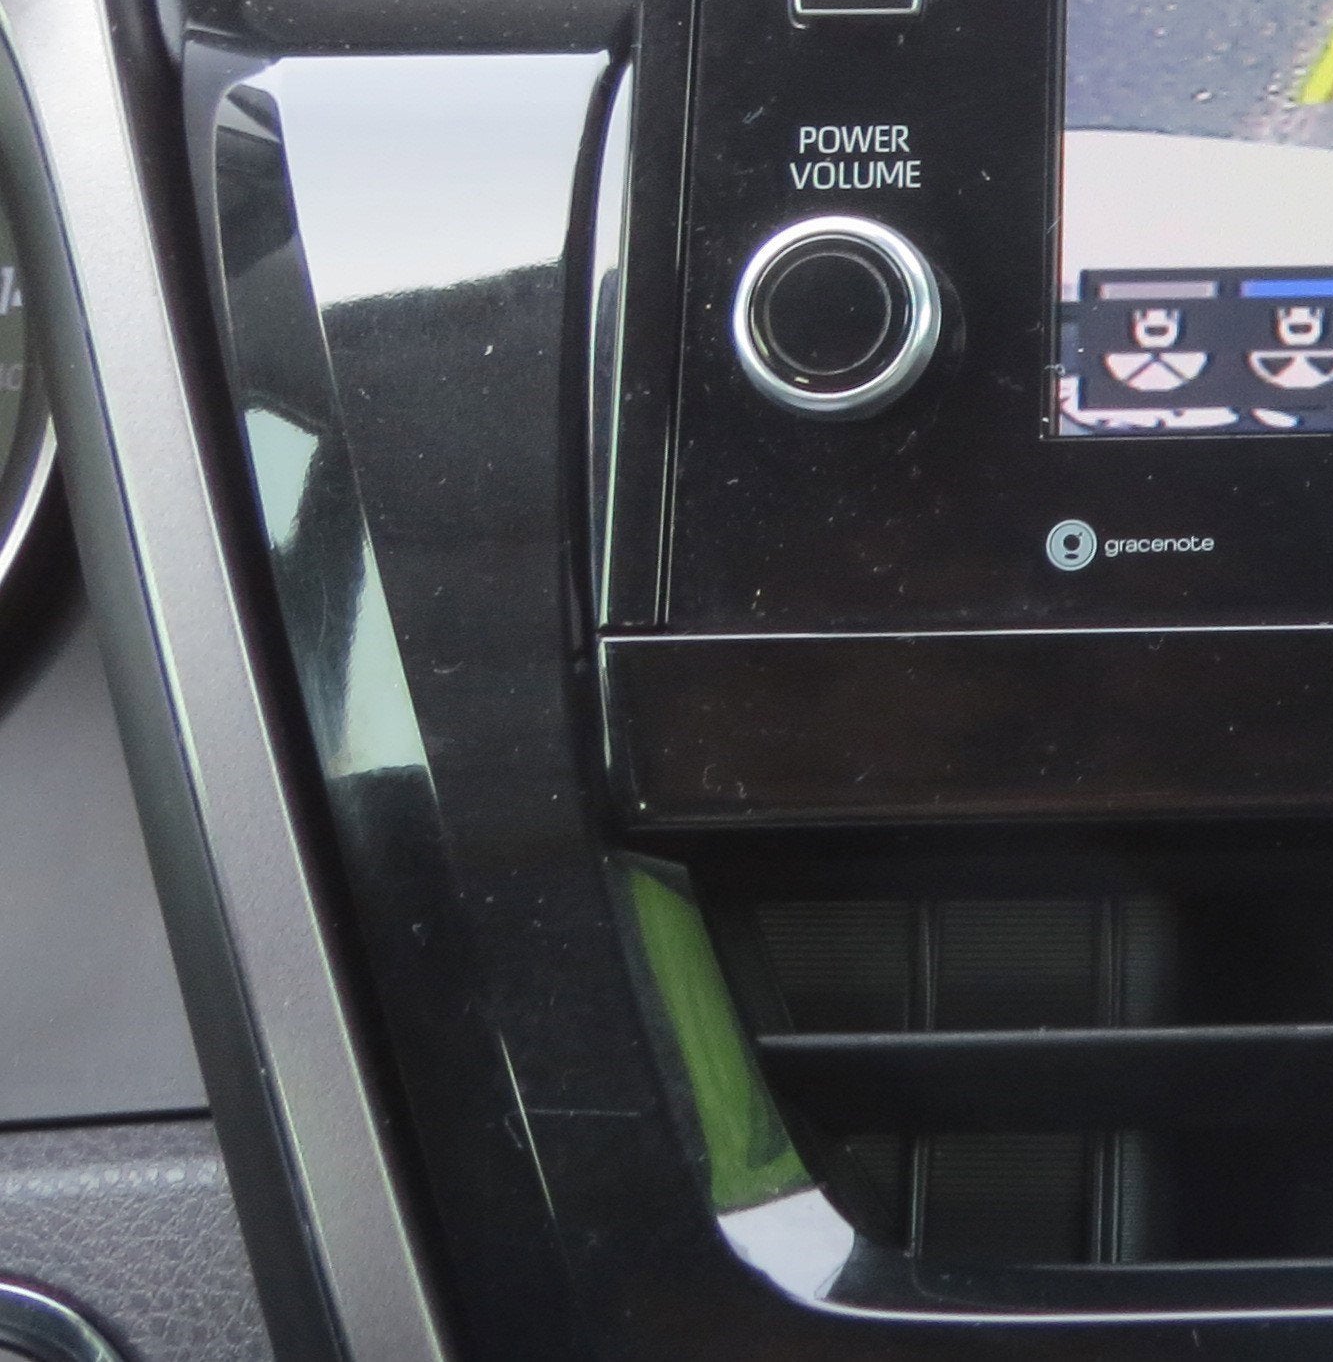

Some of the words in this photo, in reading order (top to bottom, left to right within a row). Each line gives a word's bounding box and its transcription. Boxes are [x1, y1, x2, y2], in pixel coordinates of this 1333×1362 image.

[798, 126, 909, 154] POWER
[790, 161, 921, 190] VOLUME
[1104, 536, 1215, 558] gracenote
